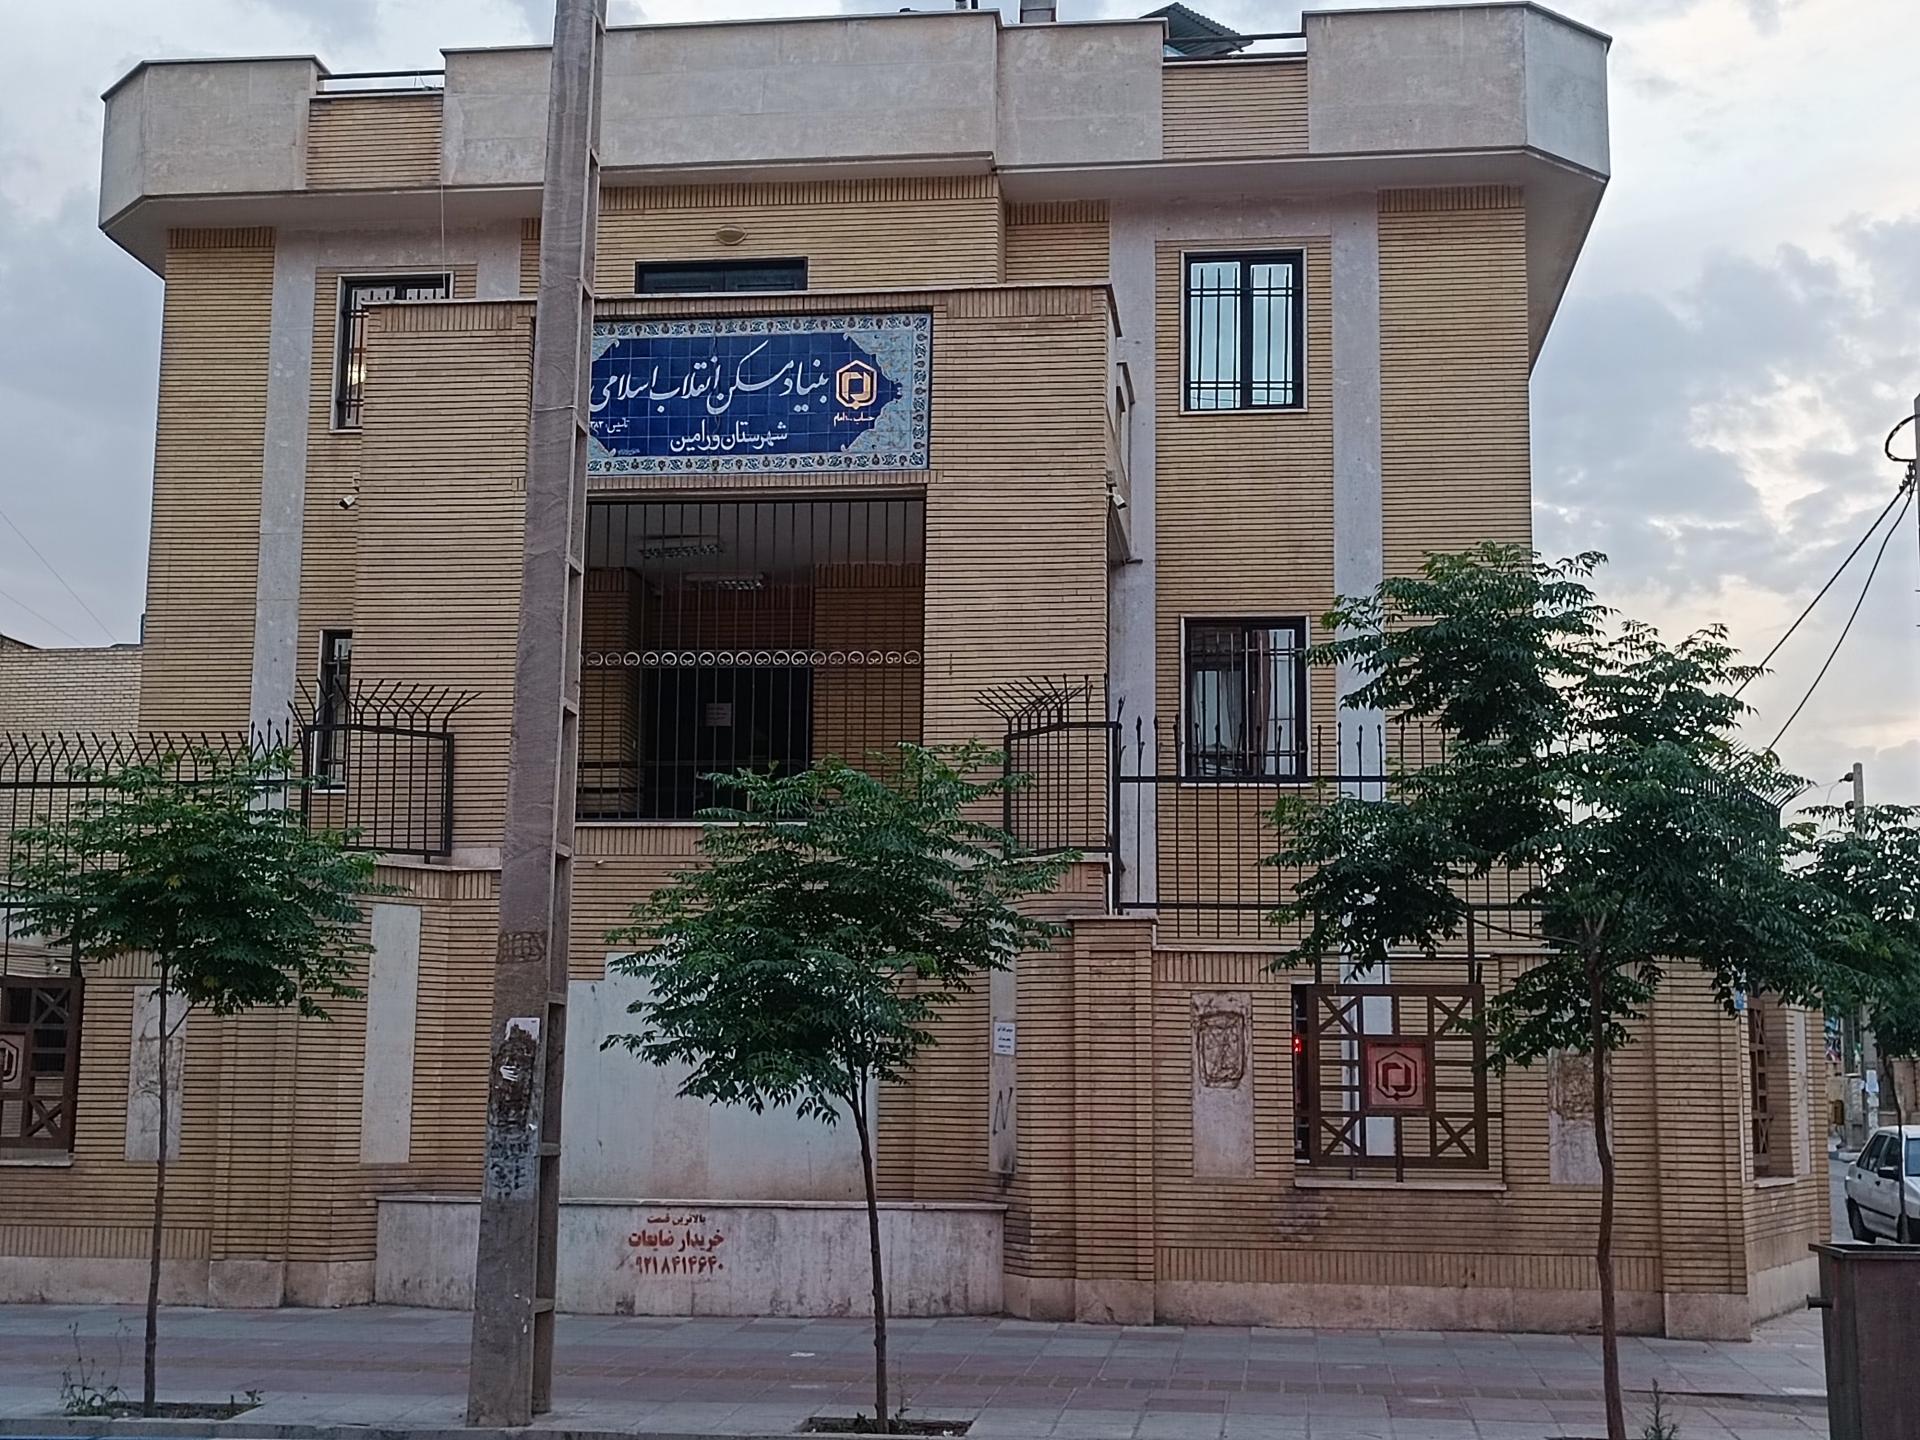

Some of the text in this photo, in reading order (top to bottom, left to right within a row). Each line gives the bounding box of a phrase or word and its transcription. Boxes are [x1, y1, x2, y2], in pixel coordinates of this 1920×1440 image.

[589, 340, 829, 415] بنیاد مسکن انقلاب اسلامی
[670, 419, 788, 452] شهرستان ورامین
[628, 1228, 725, 1252] خریدار ضایعات
